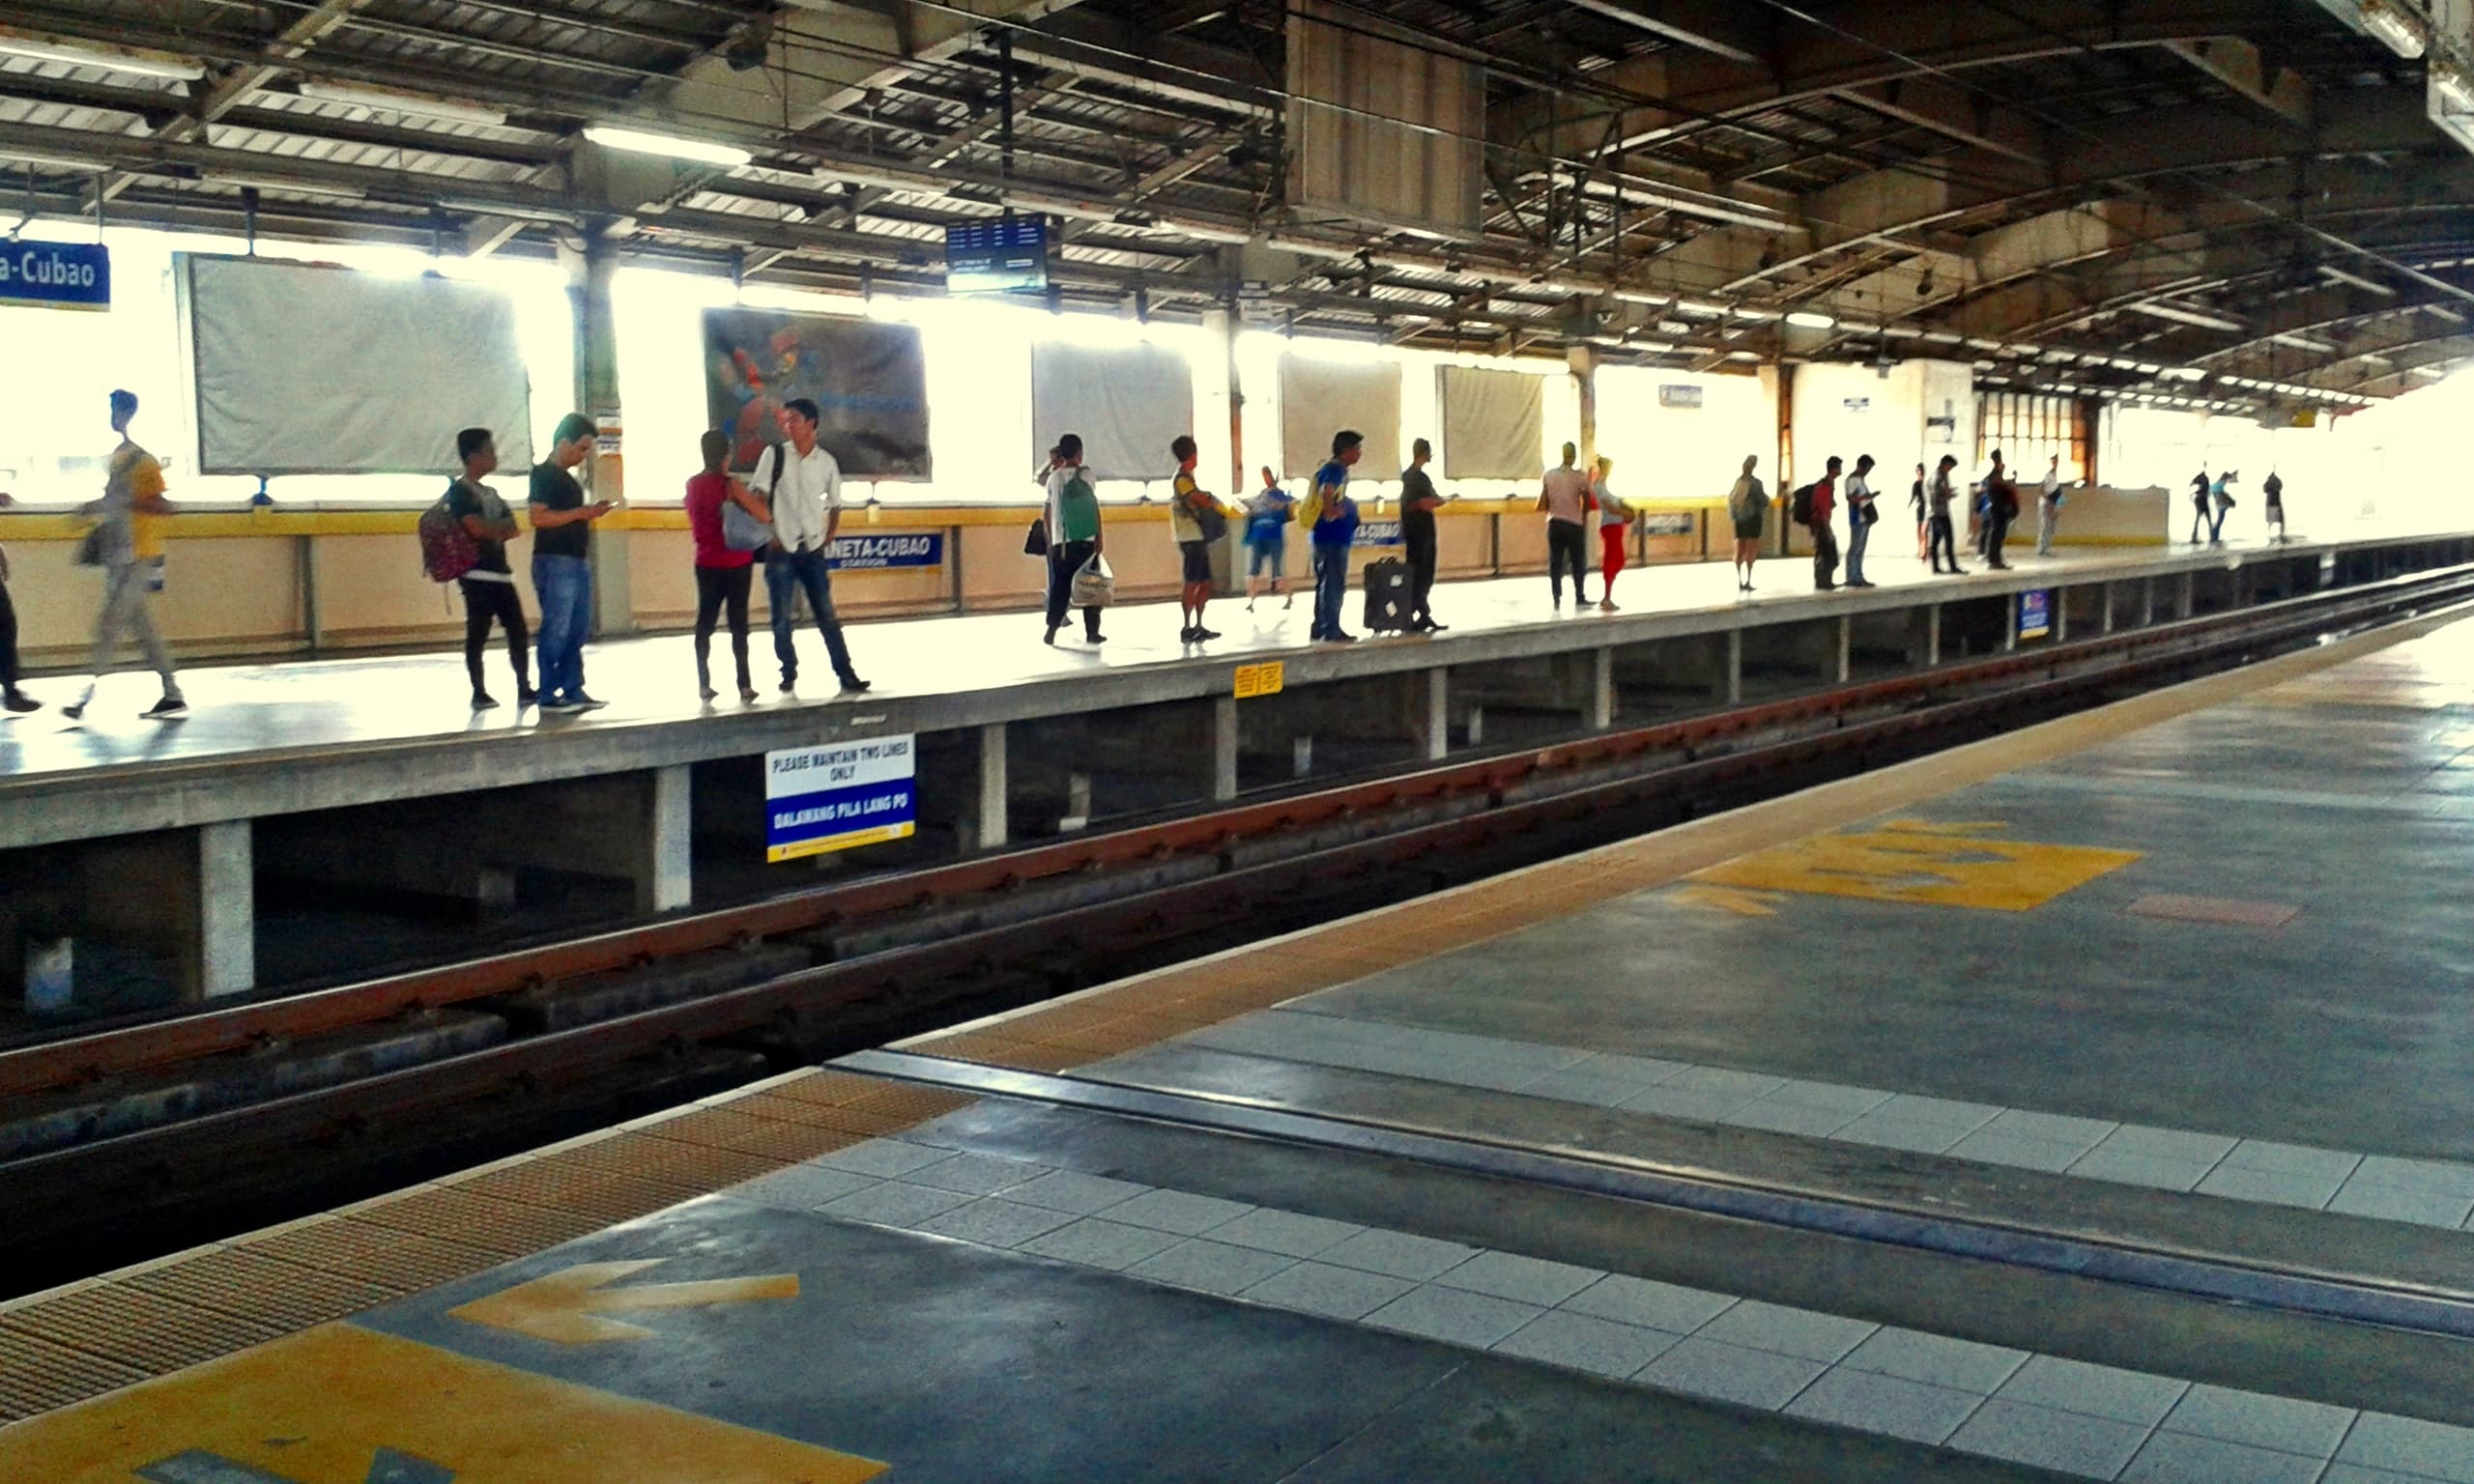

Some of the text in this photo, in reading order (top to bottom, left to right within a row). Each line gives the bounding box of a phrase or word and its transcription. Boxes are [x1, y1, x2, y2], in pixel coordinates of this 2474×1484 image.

[773, 741, 908, 774] PLEASE MAINTAIN TWO LINES
[830, 766, 855, 782] ONLY
[837, 801, 861, 819] PILA
[863, 795, 892, 814] LANG
[893, 792, 908, 810] PO
